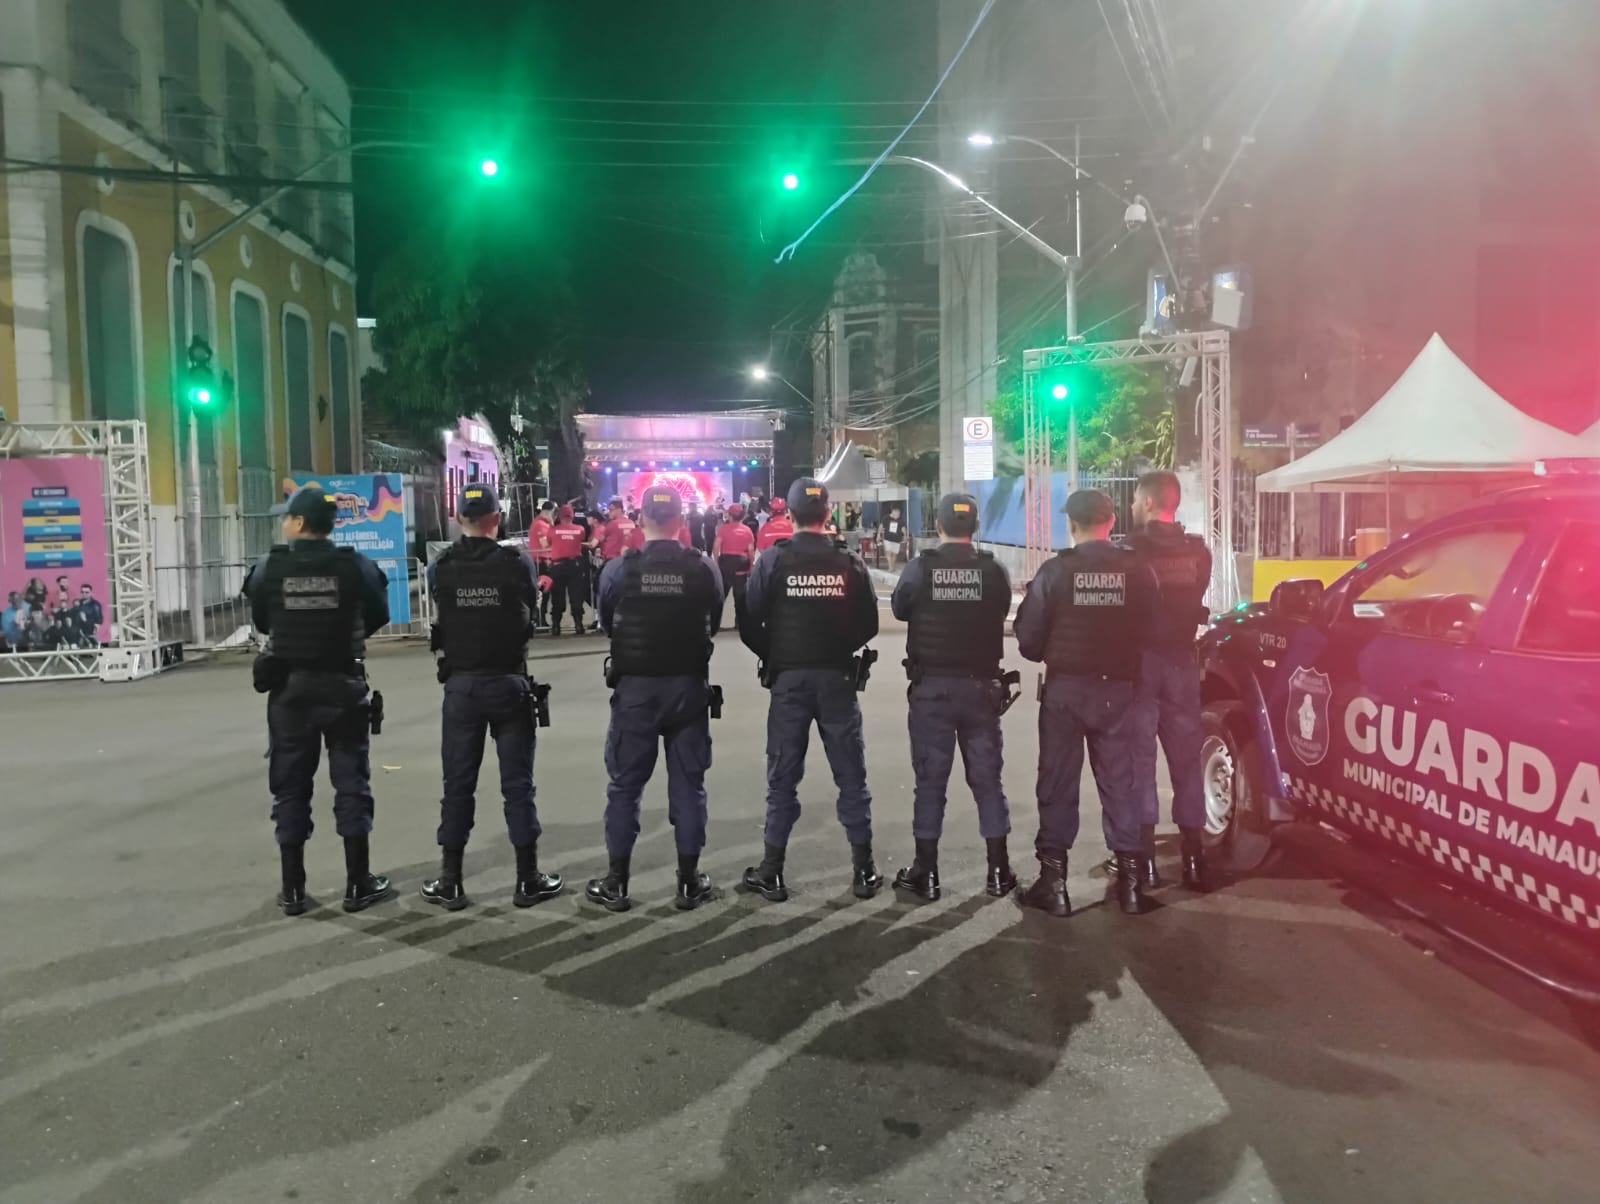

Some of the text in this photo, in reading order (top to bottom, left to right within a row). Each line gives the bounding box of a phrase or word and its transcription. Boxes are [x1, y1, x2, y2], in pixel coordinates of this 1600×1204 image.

[973, 423, 983, 435] E
[641, 574, 684, 584] GUARDA
[786, 574, 845, 586] GUARDA
[934, 571, 980, 584] GUARDA
[1076, 574, 1123, 588] GUARDA
[456, 587, 499, 597] GUARDA
[786, 587, 845, 597] MUNICIPAL
[934, 588, 980, 599] MUNICIPAL
[1075, 592, 1123, 604] MUNICIPAL
[456, 597, 500, 607] MUNICIPAL
[1259, 631, 1287, 649] VTR 20
[1344, 697, 1600, 837] GUARDA
[1343, 758, 1600, 881] MUNICIPAL DE MANAU
